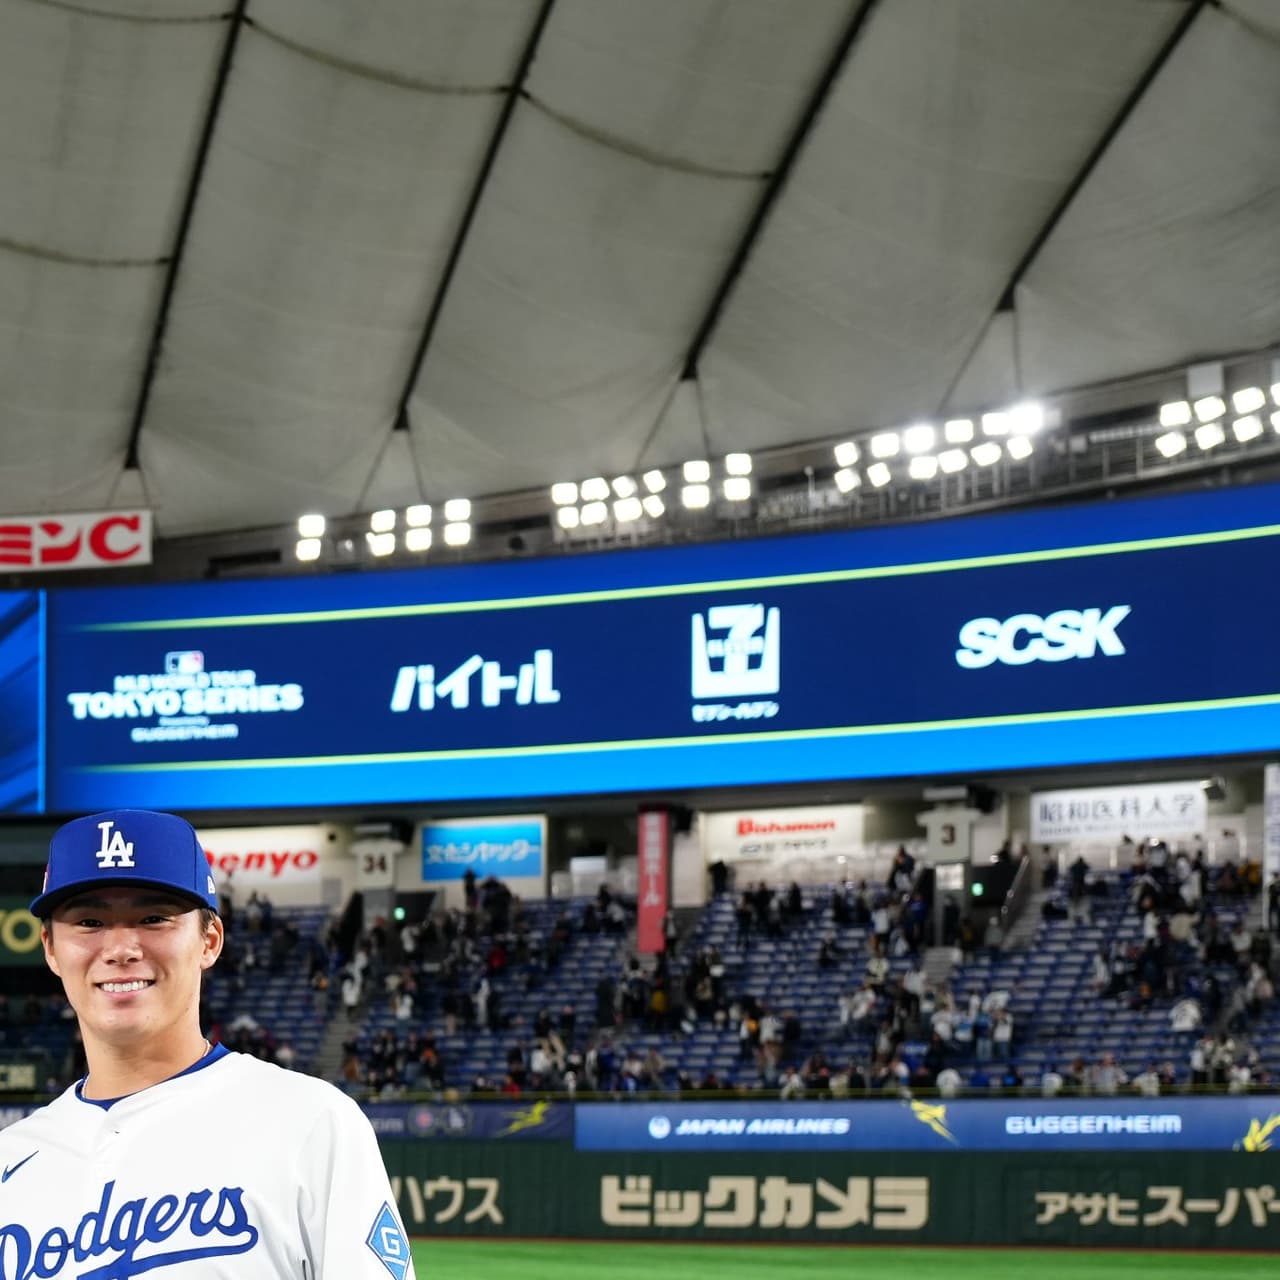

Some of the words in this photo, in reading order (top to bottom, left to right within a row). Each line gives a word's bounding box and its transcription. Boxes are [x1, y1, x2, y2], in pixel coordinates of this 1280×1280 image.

[955, 605, 1131, 669] SCSK
[68, 689, 181, 719] TOKYO
[182, 683, 304, 715] SERIES
[95, 821, 135, 868] LA
[676, 1118, 745, 1135] JAPAN
[746, 1118, 850, 1135] AIRLINES
[1006, 1115, 1182, 1135] GUGGENHEIM
[601, 1175, 929, 1230] ビックカメラ
[380, 1226, 401, 1256] G
